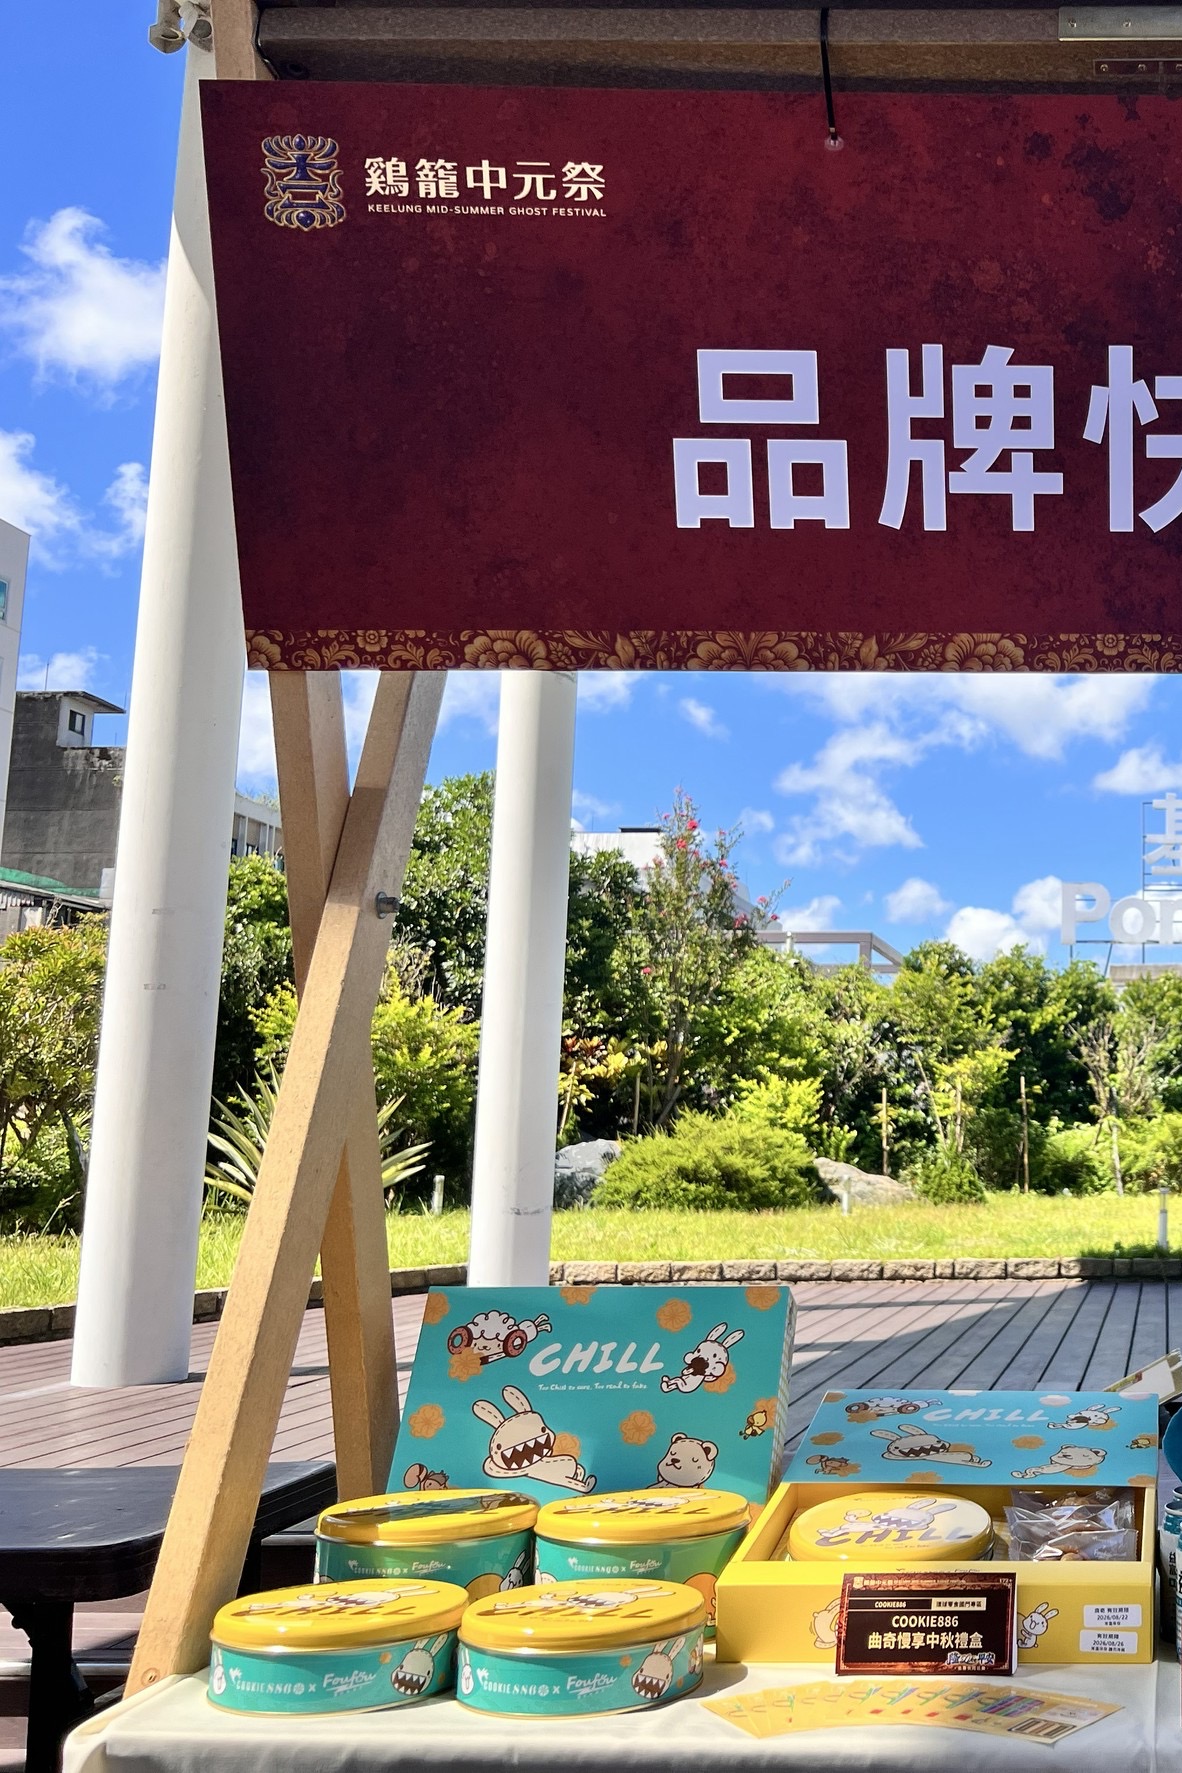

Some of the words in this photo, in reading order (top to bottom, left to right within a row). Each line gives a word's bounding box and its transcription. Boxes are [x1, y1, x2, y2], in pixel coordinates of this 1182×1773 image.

[367, 203, 422, 214] KEELUNG
[426, 205, 504, 215] MID-SUMMER
[509, 207, 548, 216] GHOST
[552, 207, 607, 217] FESTIVAL
[529, 1341, 664, 1377] CHILL
[923, 1408, 1049, 1422] CHILL
[815, 1527, 973, 1547] CHILL
[891, 1615, 959, 1628] COOKIE886
[868, 1631, 984, 1650] 曲奇慢享中秋禮盒
